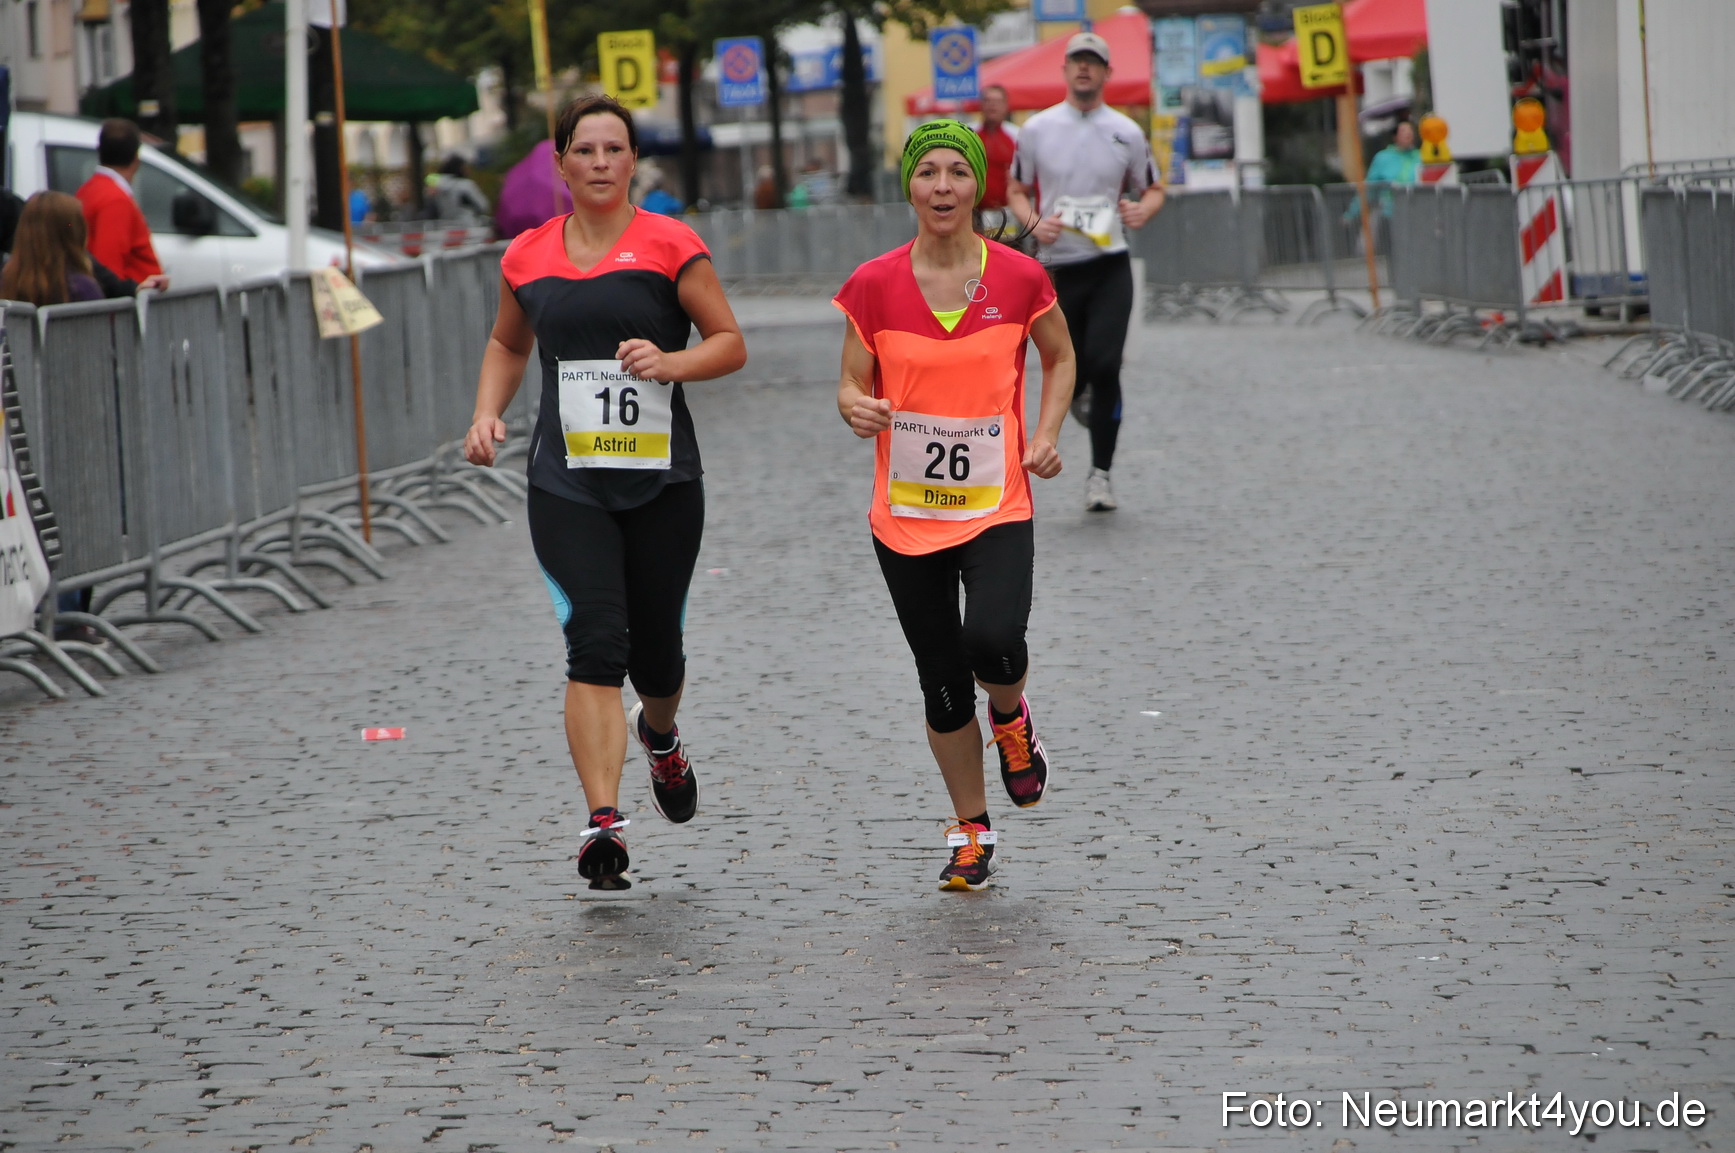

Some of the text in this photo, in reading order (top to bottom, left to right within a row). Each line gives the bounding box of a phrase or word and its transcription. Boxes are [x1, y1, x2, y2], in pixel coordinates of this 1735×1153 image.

[1311, 31, 1336, 66] D
[616, 56, 641, 91] D
[561, 371, 652, 383] PARTL Neuma
[595, 387, 640, 426] 16
[894, 421, 985, 438] PARTL Neumarkt
[593, 436, 637, 452] Astrid
[924, 442, 970, 481] 26
[924, 489, 967, 506] Diana
